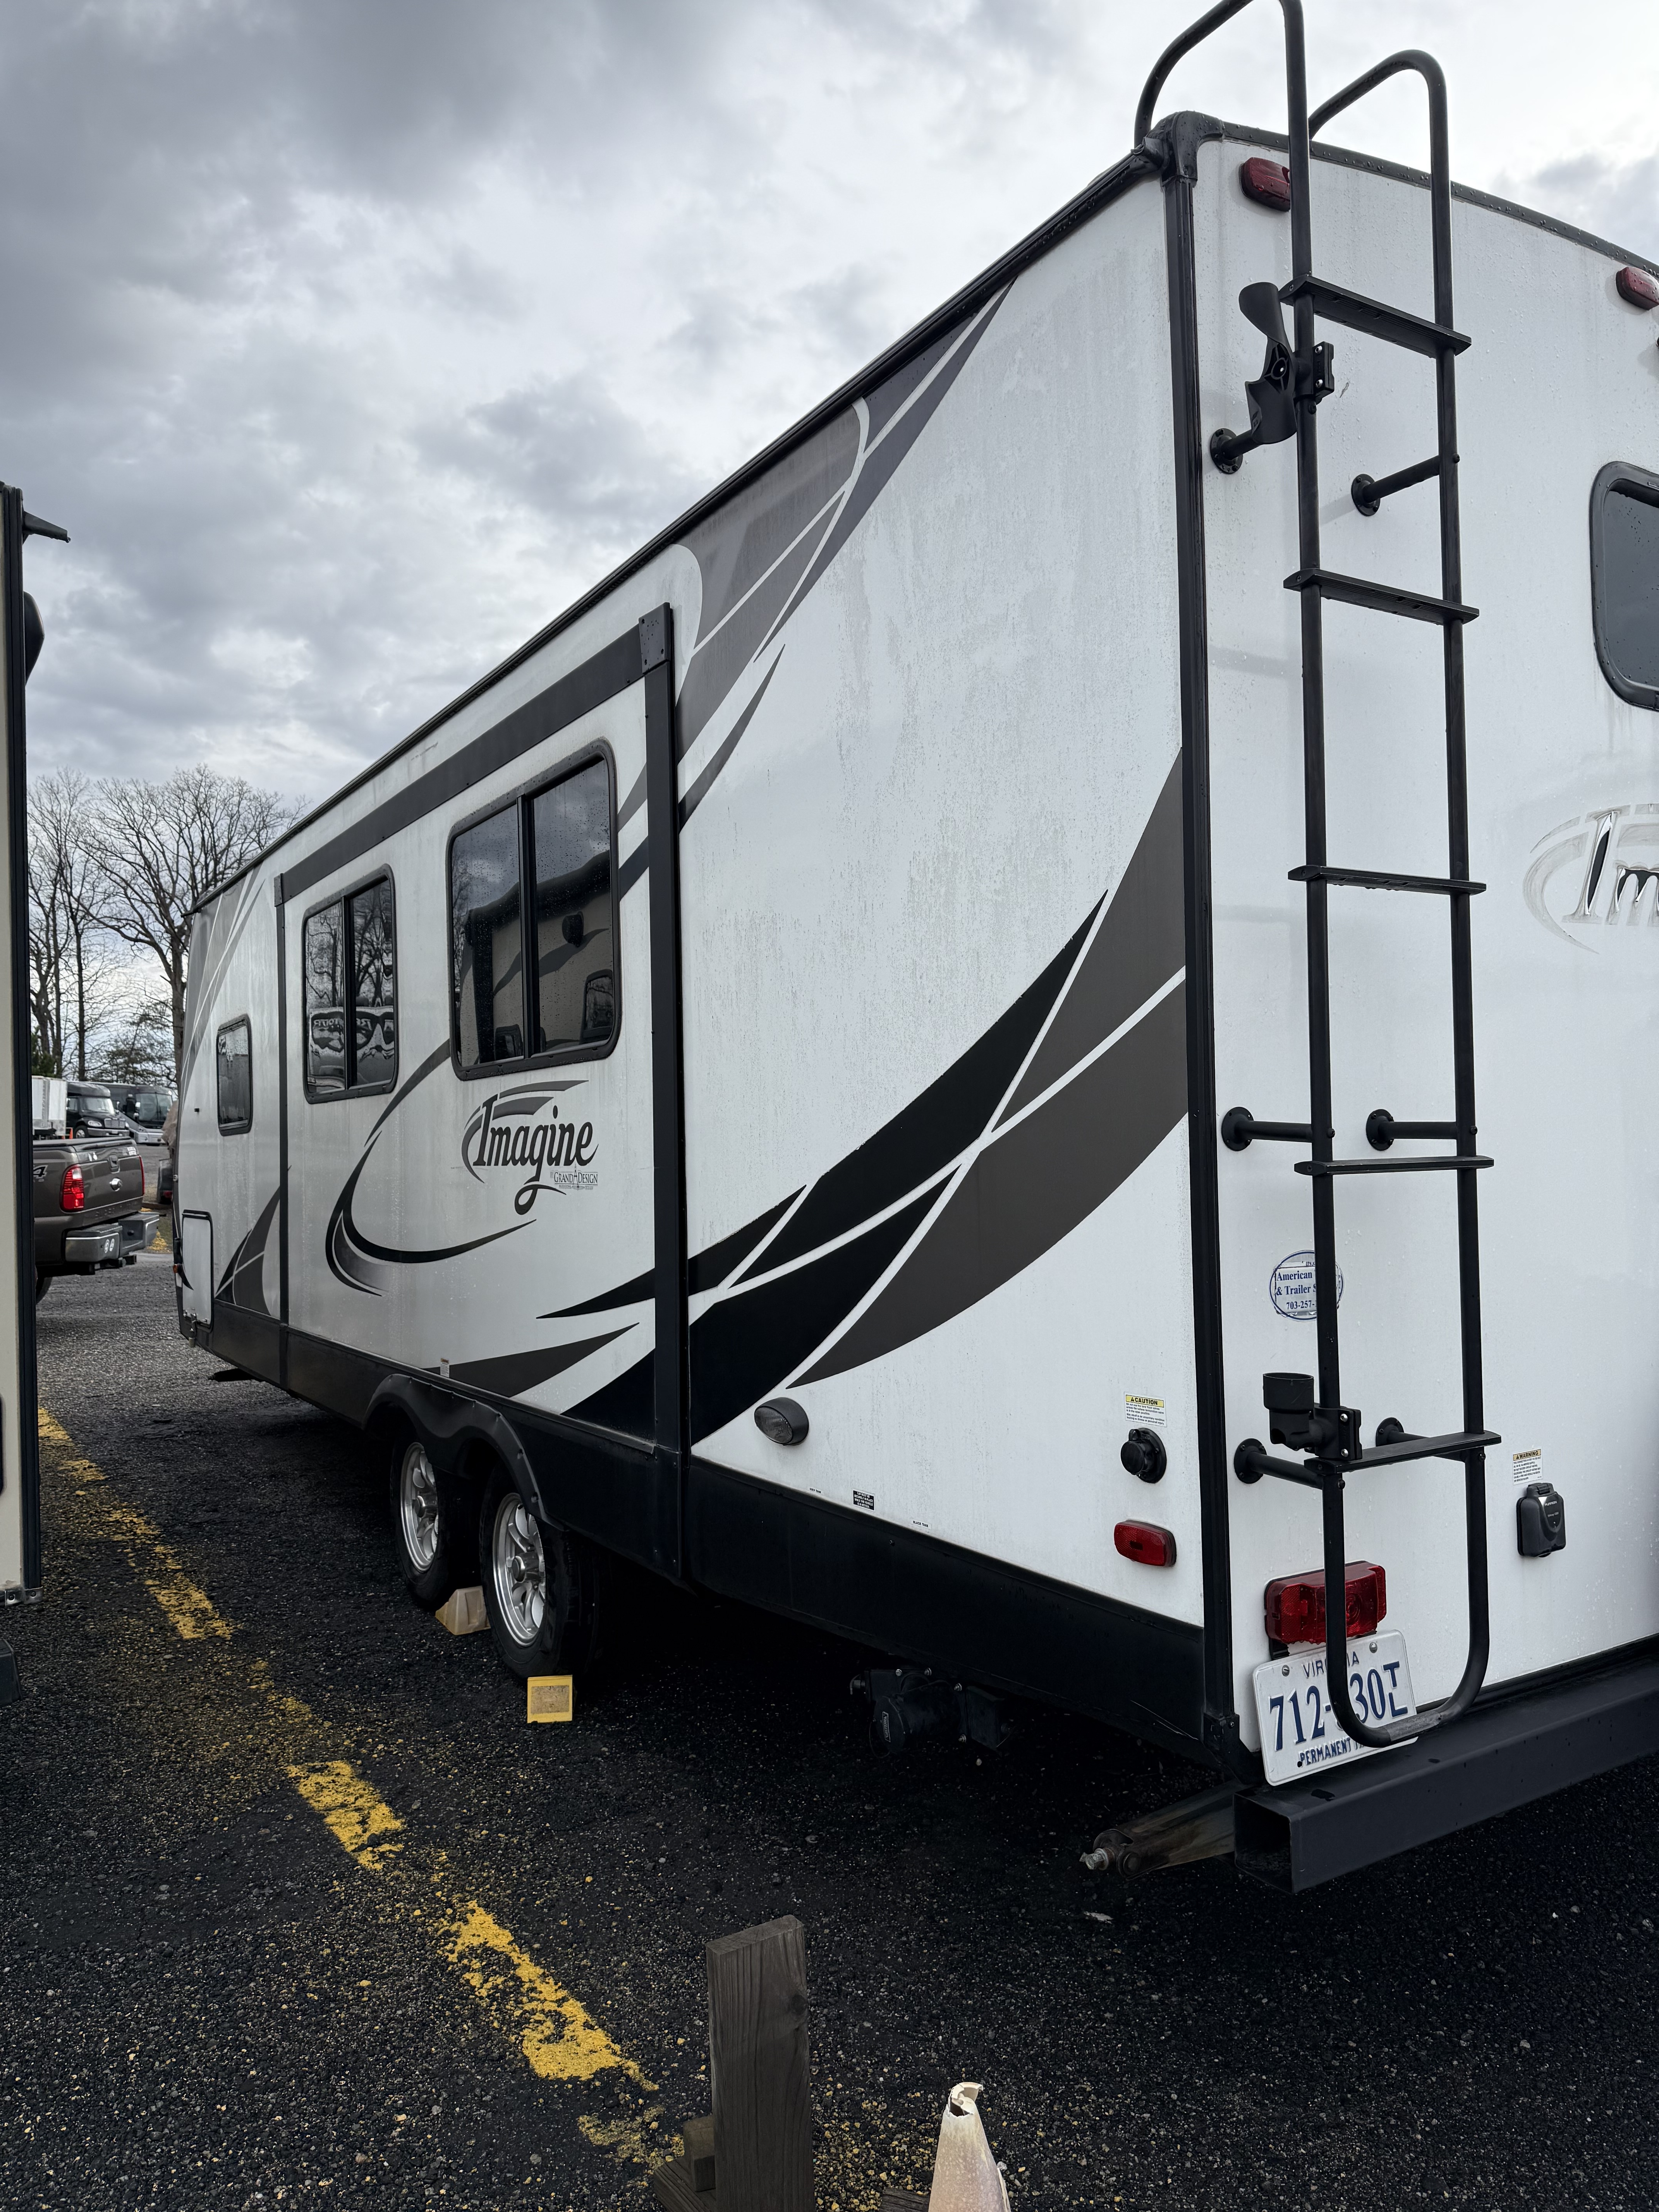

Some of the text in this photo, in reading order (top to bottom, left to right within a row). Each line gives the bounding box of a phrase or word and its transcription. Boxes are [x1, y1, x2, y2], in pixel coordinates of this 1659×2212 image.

[473, 1094, 599, 1215] Imagine
[554, 1172, 598, 1183] GRAND DESIGN
[1277, 1270, 1312, 1281] American
[1276, 1286, 1282, 1295] &
[1285, 1285, 1311, 1295] Trailer
[1286, 1300, 1316, 1310] 703-257-
[1135, 1397, 1158, 1405] CAUTION
[1519, 1450, 1539, 1459] WARNING
[1303, 1651, 1360, 1678] VIRIA
[1300, 1737, 1351, 1765] PERMANENT
